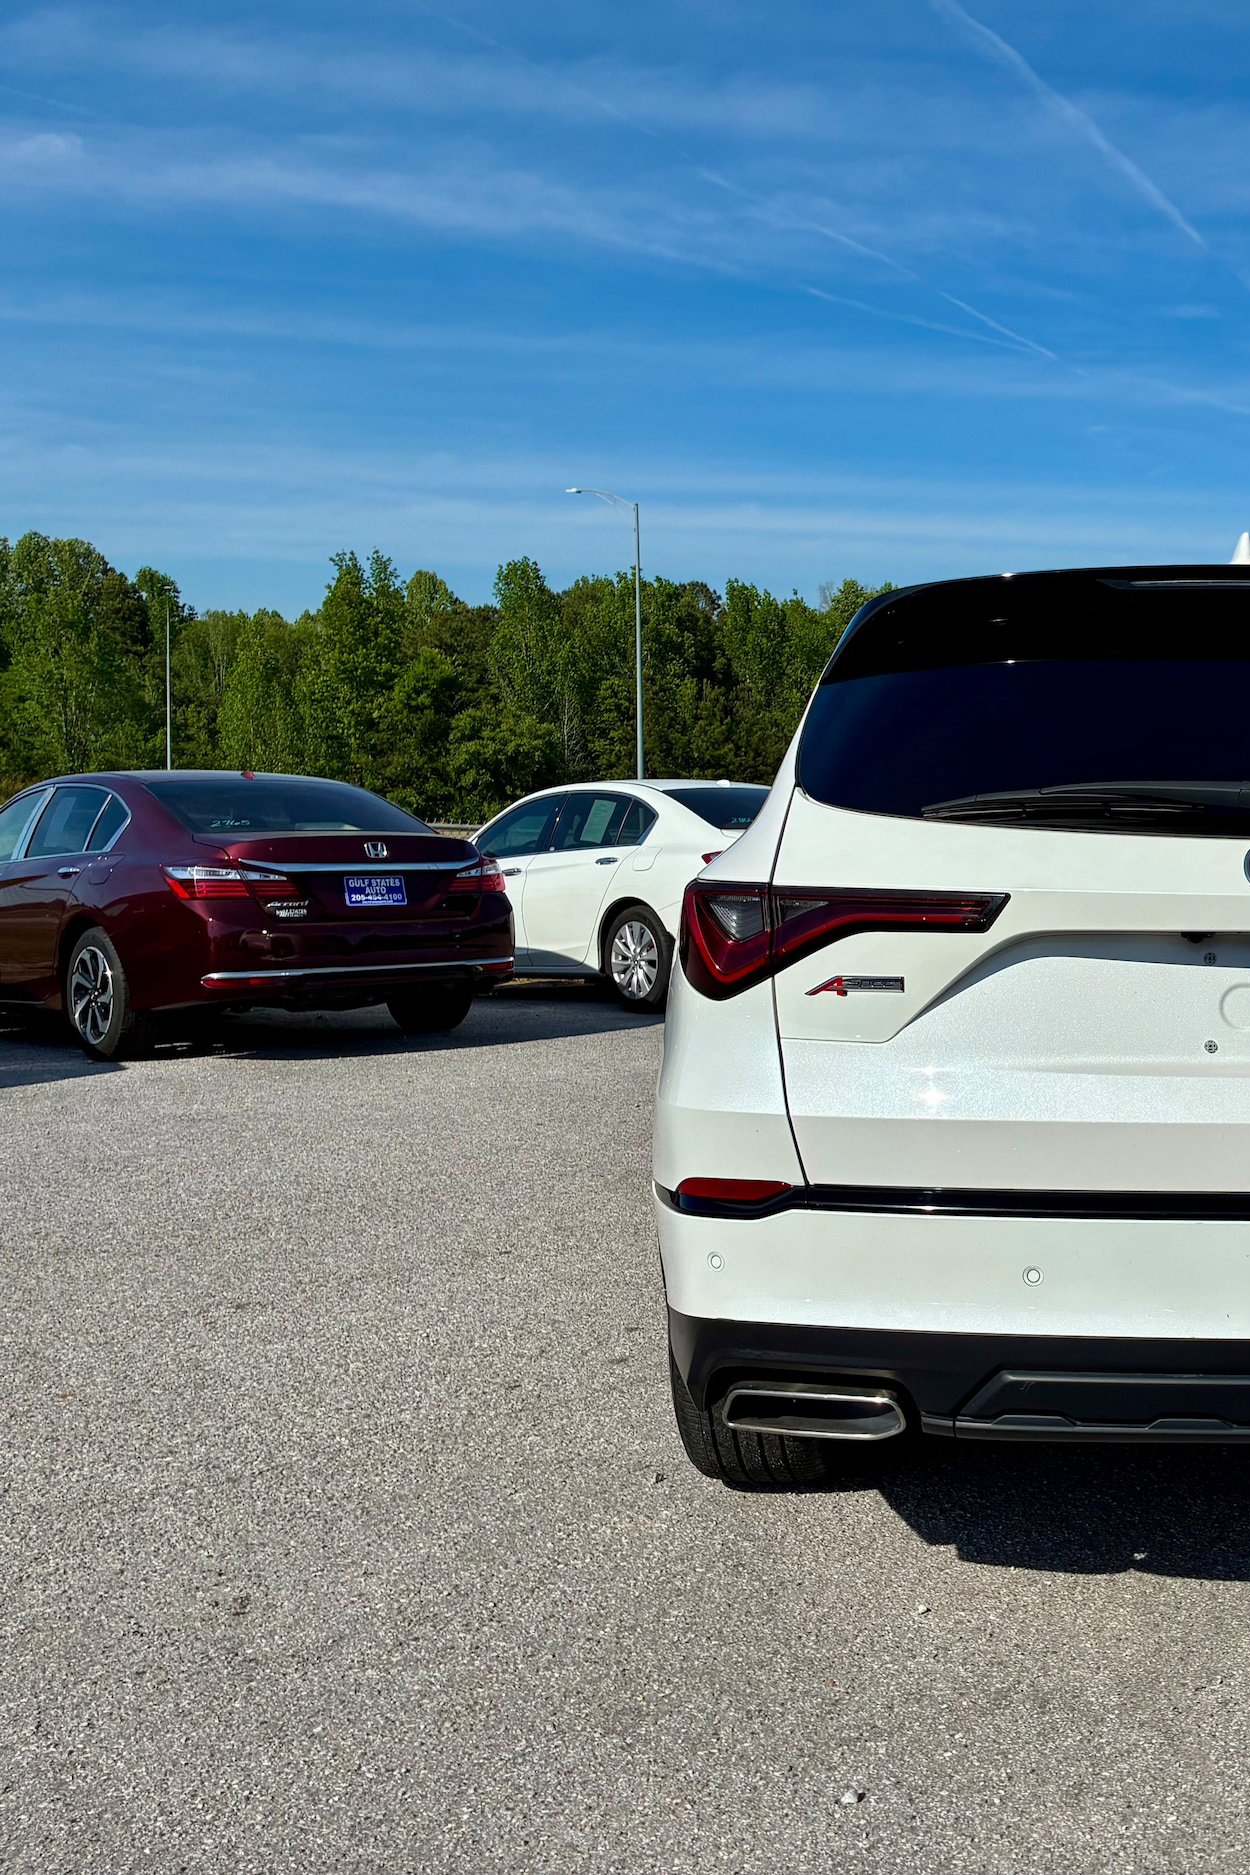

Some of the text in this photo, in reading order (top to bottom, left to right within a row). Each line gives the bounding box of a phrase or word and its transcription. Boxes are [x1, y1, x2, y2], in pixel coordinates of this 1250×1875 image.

[348, 878, 401, 888] GULF STATES
[365, 886, 387, 895] AUTO
